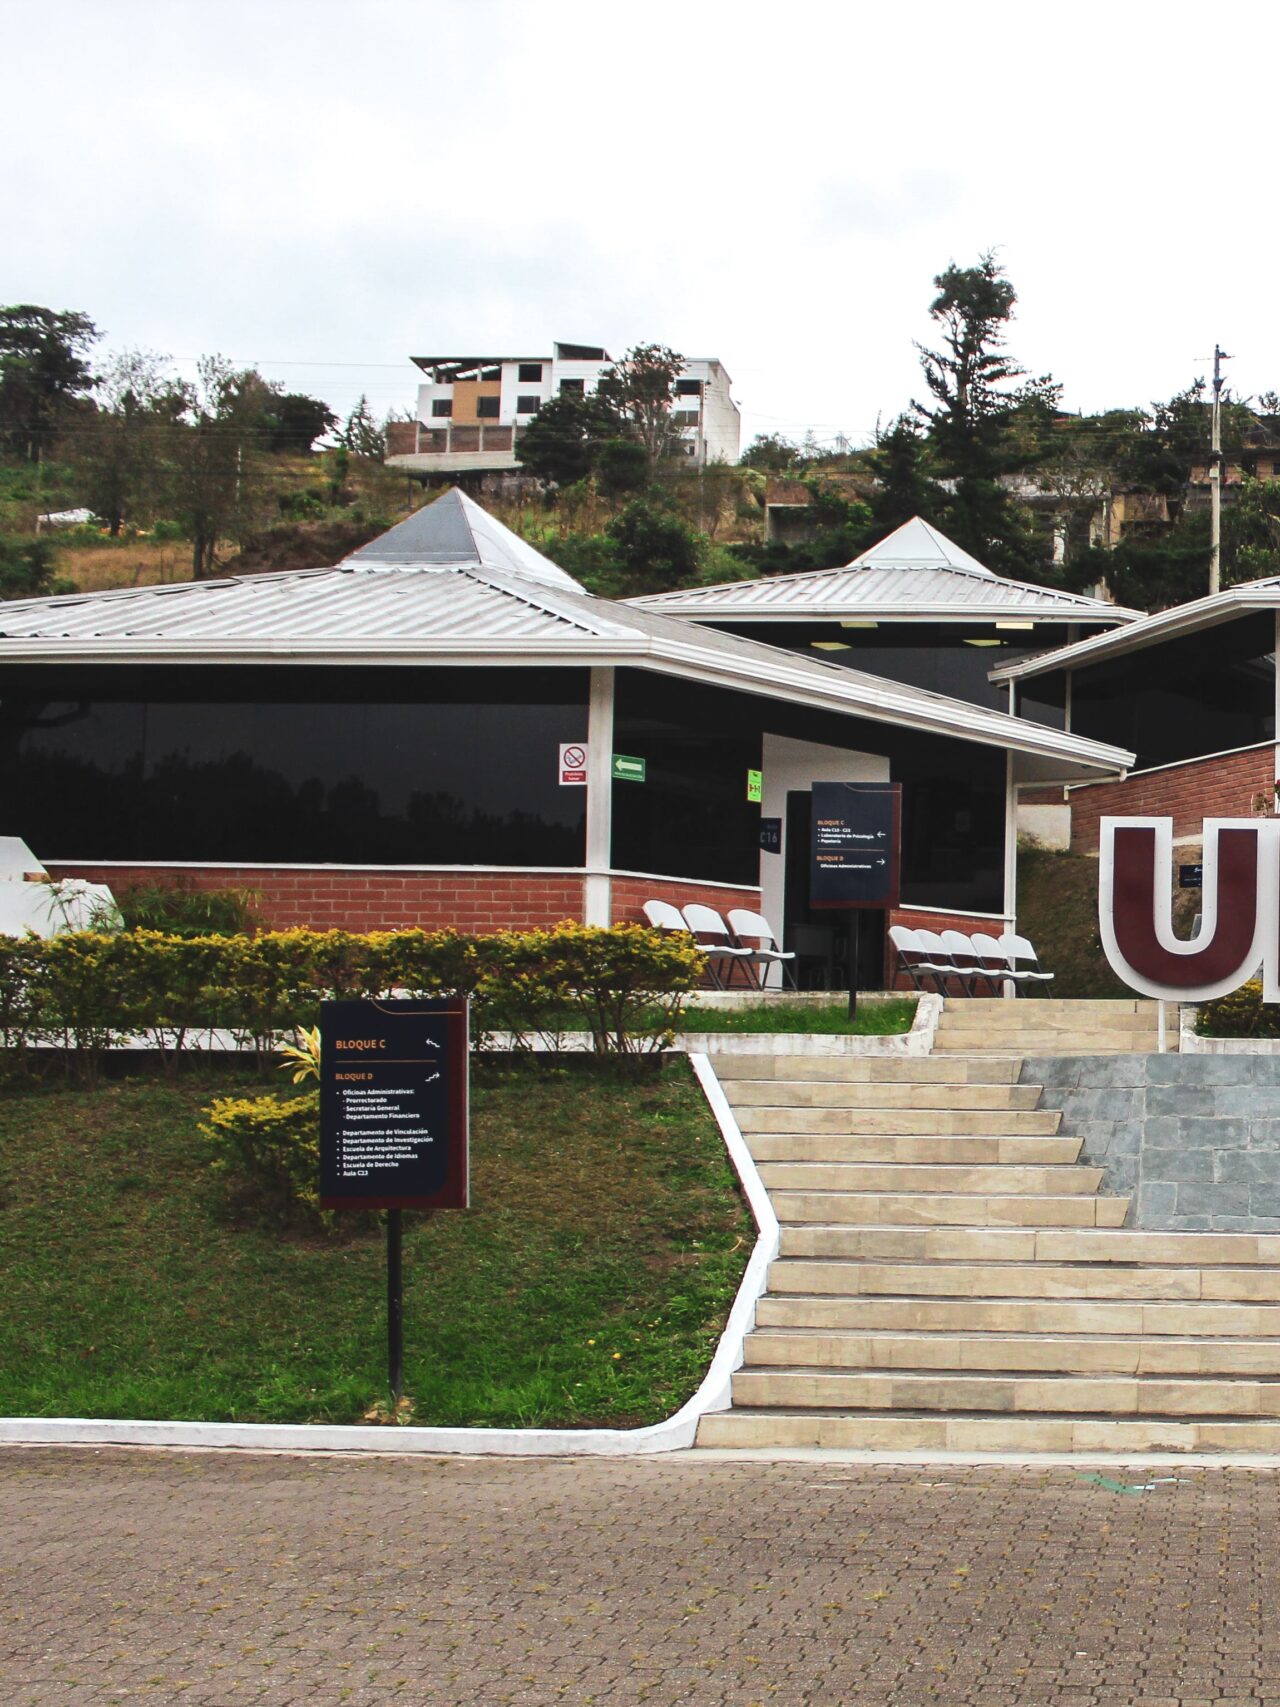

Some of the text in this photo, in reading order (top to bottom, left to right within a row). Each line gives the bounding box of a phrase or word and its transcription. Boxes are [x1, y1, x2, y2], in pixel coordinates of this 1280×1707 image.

[336, 1040, 386, 1050] BLOQUE C
[335, 1072, 366, 1081] BLOQUE
[394, 1136, 434, 1144] Investigación
